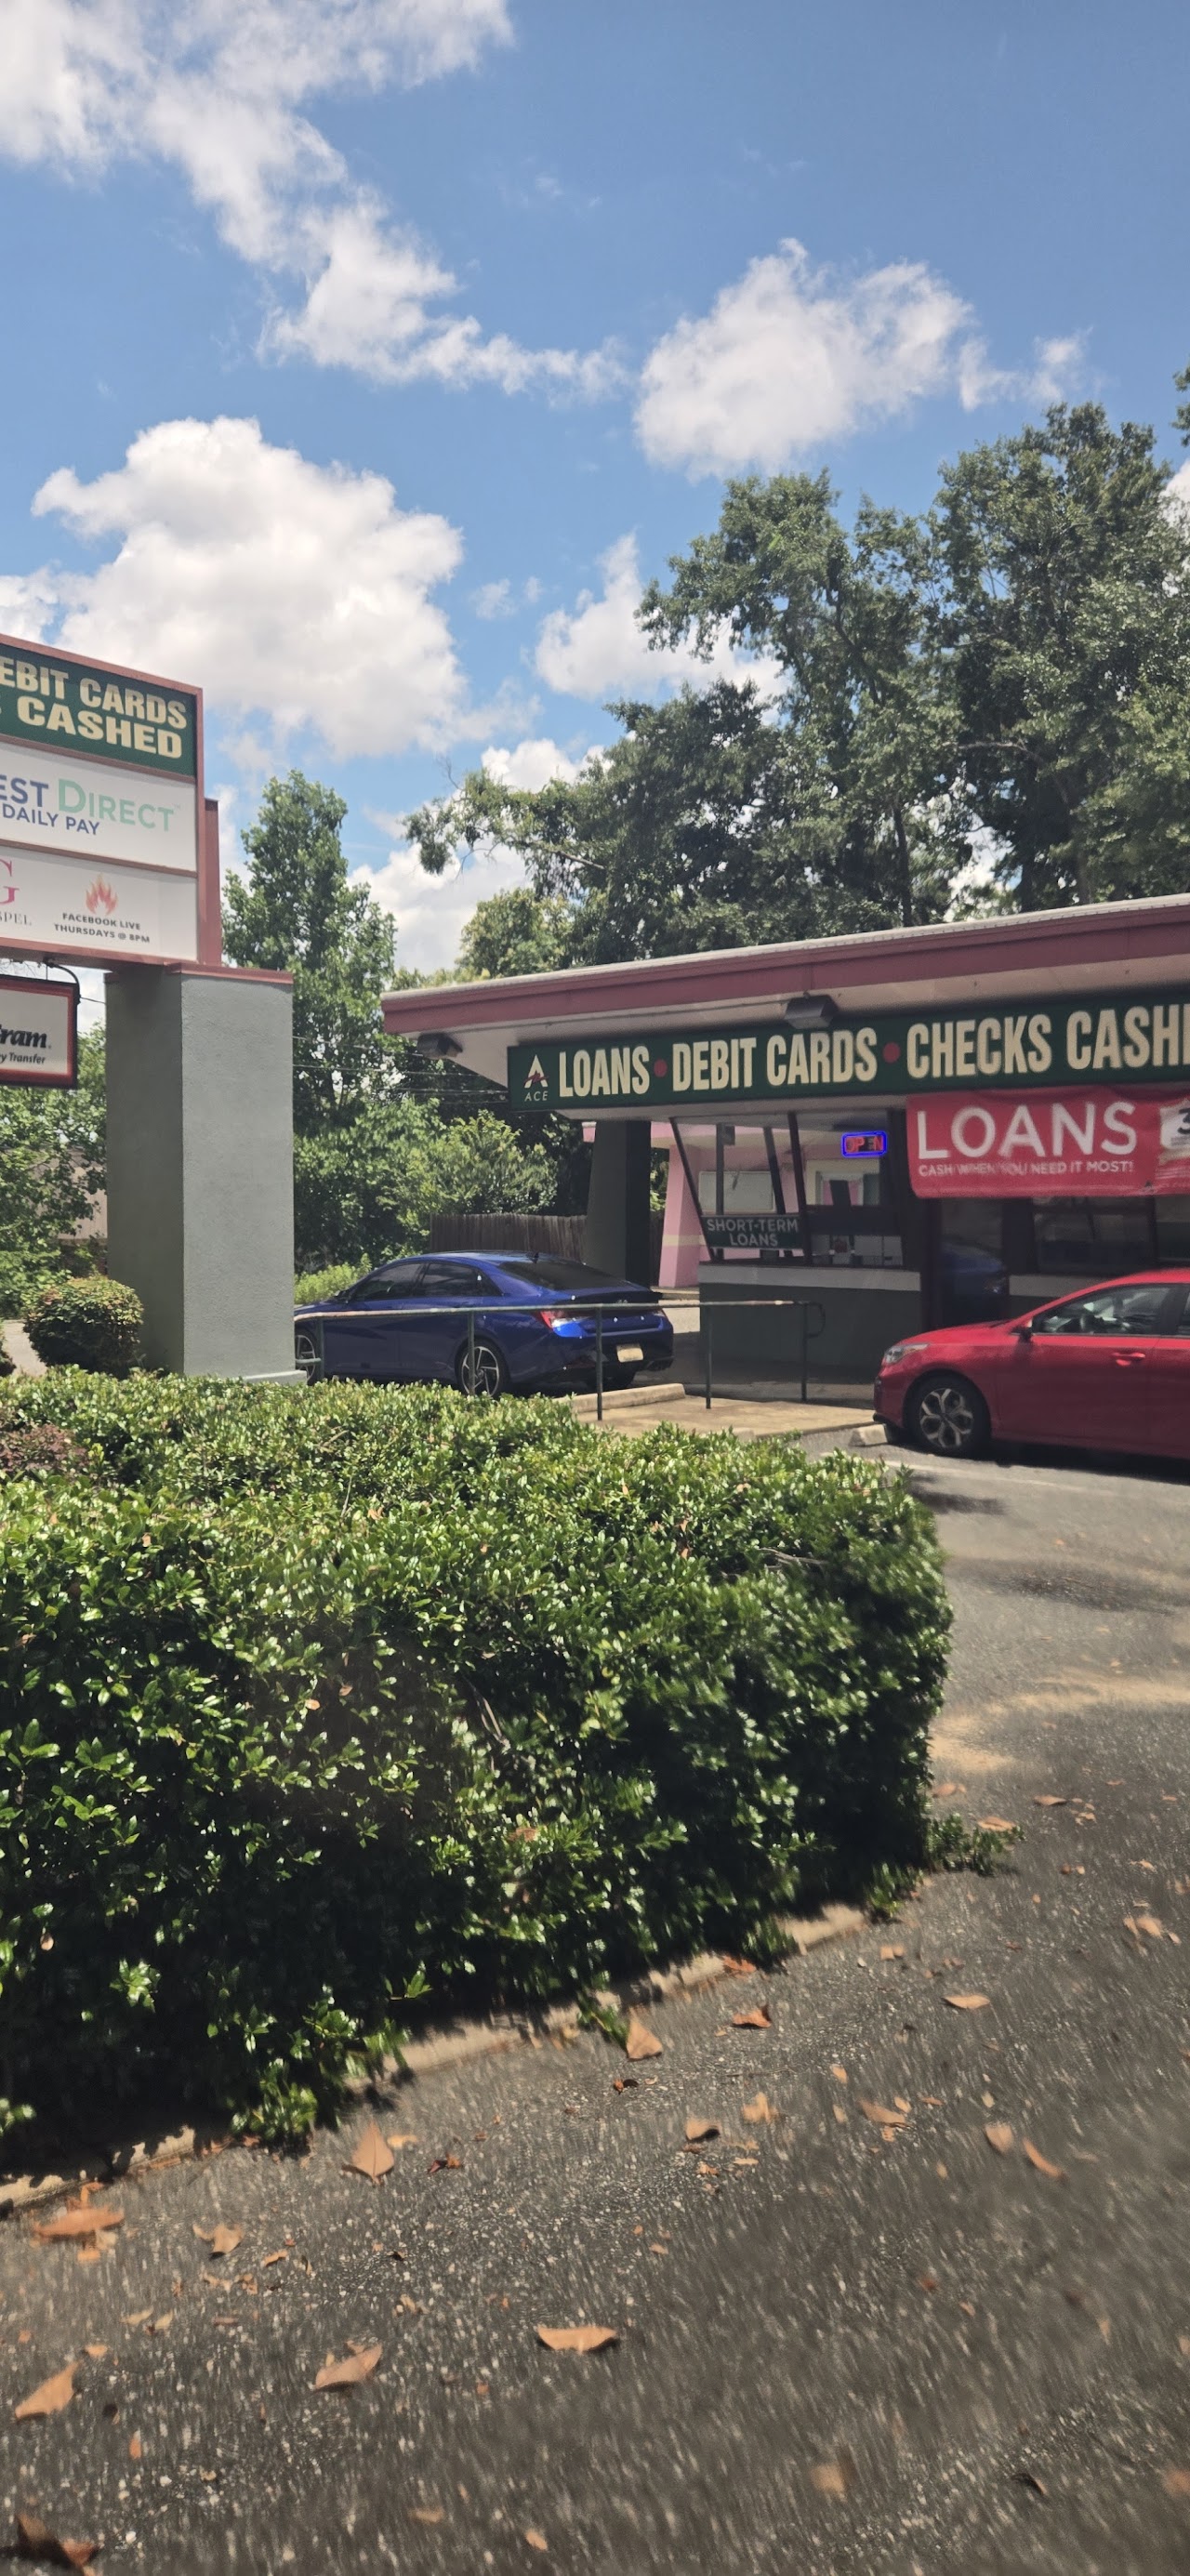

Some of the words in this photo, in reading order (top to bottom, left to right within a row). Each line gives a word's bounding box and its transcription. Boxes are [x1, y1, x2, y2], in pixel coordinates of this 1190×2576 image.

[80, 678, 187, 730] CARDS
[17, 695, 182, 759] CASHED
[3, 803, 59, 827] DAILY
[66, 816, 99, 835] PAY
[62, 913, 117, 927] FACEBOOK
[120, 919, 141, 930] LIVE
[54, 924, 115, 938] THURSDAYS
[129, 933, 150, 943] 8PM
[0, 1024, 46, 1049] ram
[9, 1052, 46, 1064] Transfer
[559, 1045, 650, 1098] LOANS
[672, 1037, 757, 1091] DEBIT
[766, 1027, 877, 1086] CARDS
[906, 1014, 1052, 1079] CHECKS
[524, 1090, 549, 1103] ACE
[918, 1102, 1137, 1159] LOANS
[919, 1165, 953, 1177] CASH
[958, 1164, 996, 1175] WHEN
[1000, 1164, 1027, 1175] YOU
[1031, 1163, 1066, 1174] NEED
[1070, 1162, 1082, 1172] IT
[1087, 1160, 1134, 1173] MOST!
[707, 1219, 799, 1233] SHORT-TERM
[730, 1233, 778, 1247] LOANS
